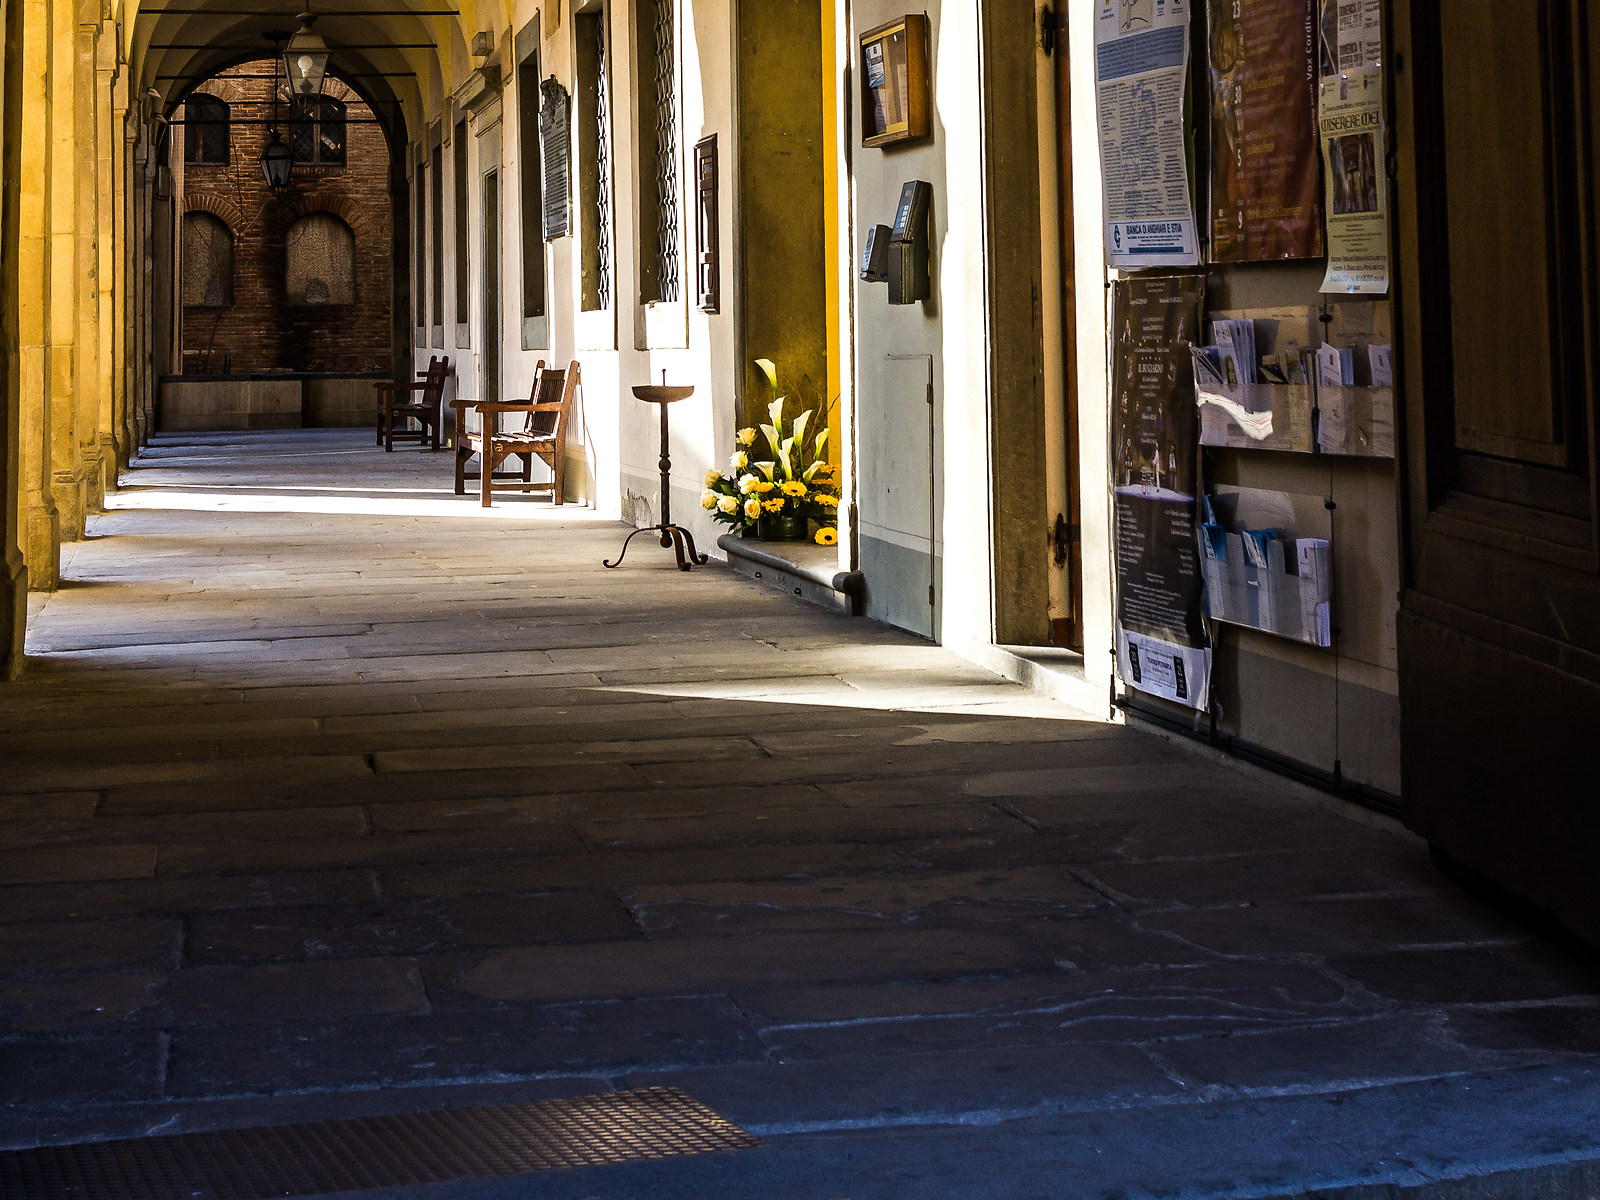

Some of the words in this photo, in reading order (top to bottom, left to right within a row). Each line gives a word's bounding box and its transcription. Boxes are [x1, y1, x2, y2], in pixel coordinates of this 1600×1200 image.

[1321, 114, 1360, 132] MISERERE
[1361, 111, 1379, 125] MEI
[1126, 225, 1141, 234] BANCA
[1172, 224, 1182, 233] STIA
